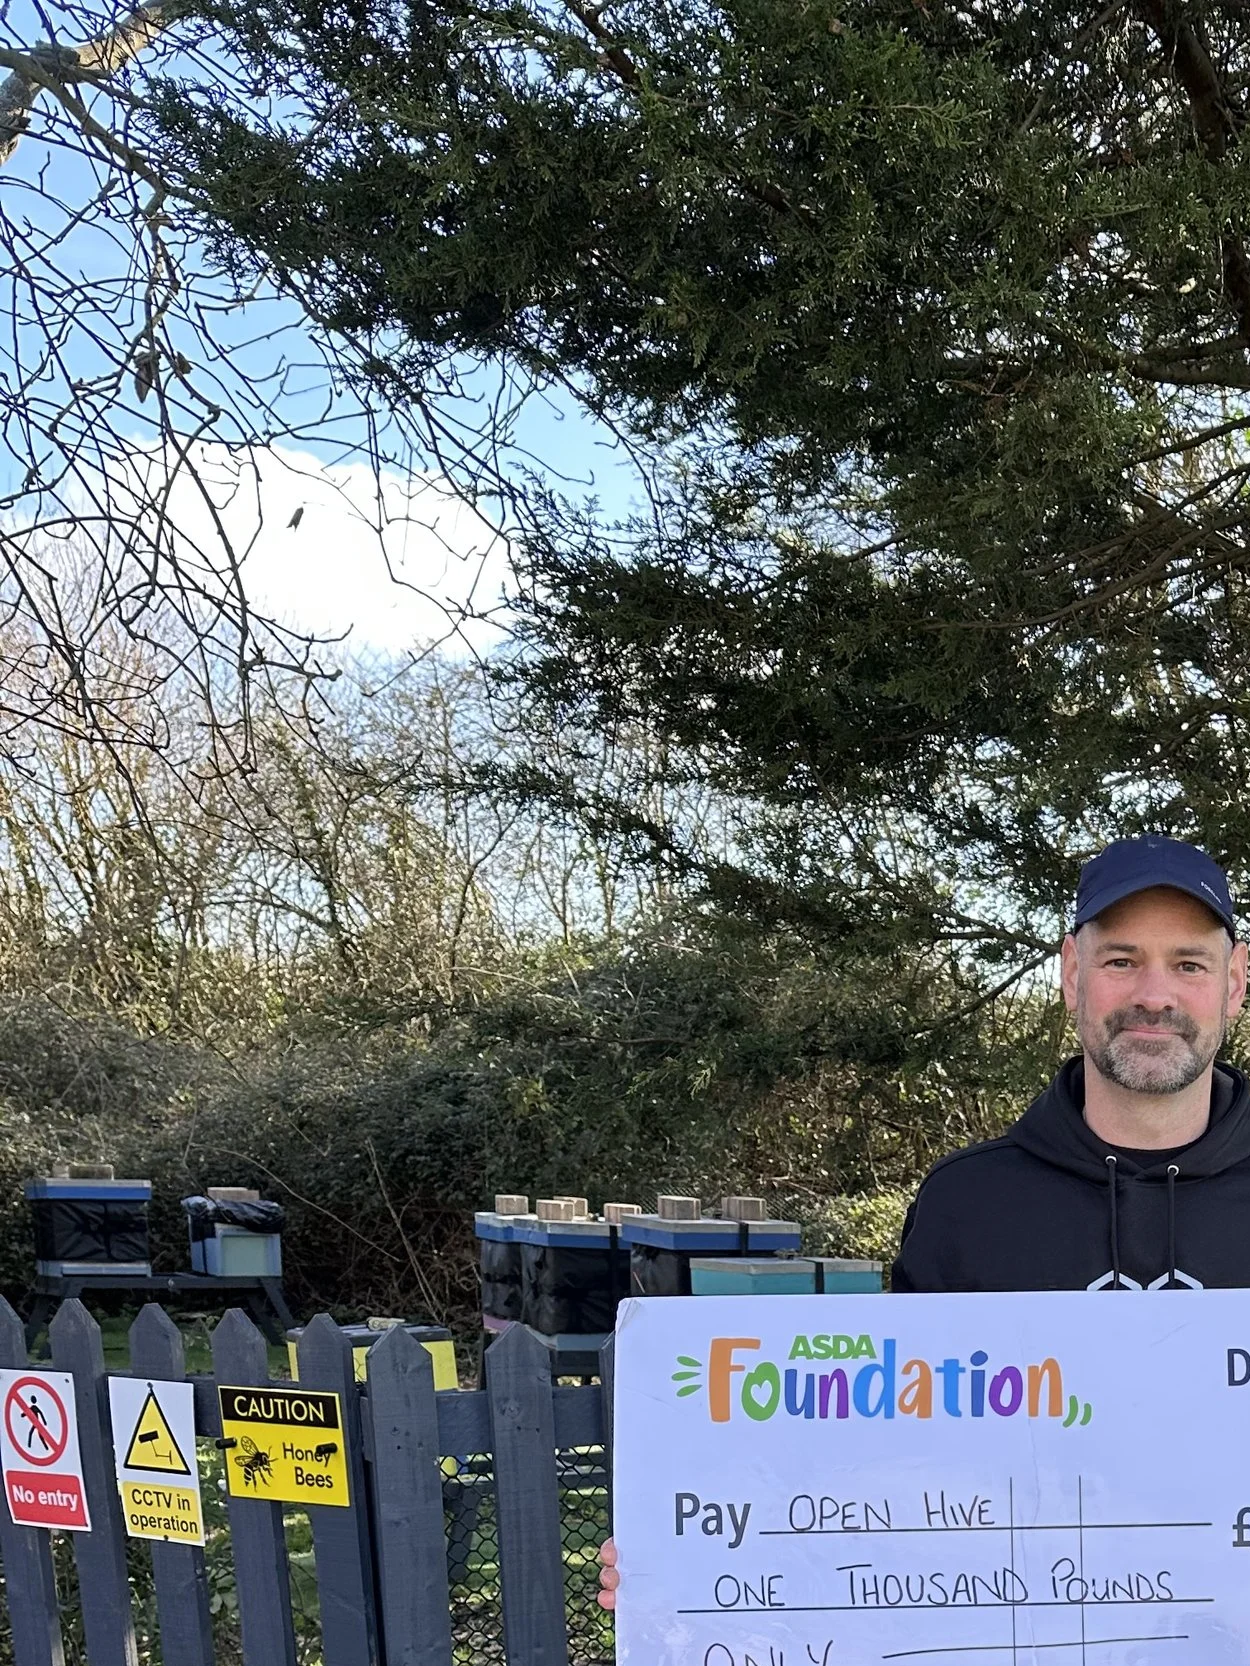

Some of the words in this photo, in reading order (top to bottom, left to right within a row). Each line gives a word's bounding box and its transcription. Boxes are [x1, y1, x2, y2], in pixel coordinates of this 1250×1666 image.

[788, 1334, 877, 1360] ASDA
[707, 1338, 1063, 1424] Foundation
[233, 1395, 325, 1422] CAUTION
[294, 1466, 334, 1488] Bees
[12, 1484, 35, 1505] No
[37, 1489, 78, 1512] entry
[131, 1488, 172, 1509] CCTV
[176, 1493, 191, 1511] in
[130, 1513, 198, 1534] operation
[675, 1492, 752, 1549] Pay
[788, 1494, 892, 1533] OPEN
[924, 1490, 996, 1528] HIVE
[714, 1574, 786, 1608] ONE
[835, 1563, 1029, 1606] THOUSAND
[1050, 1557, 1174, 1602] POUNDS
